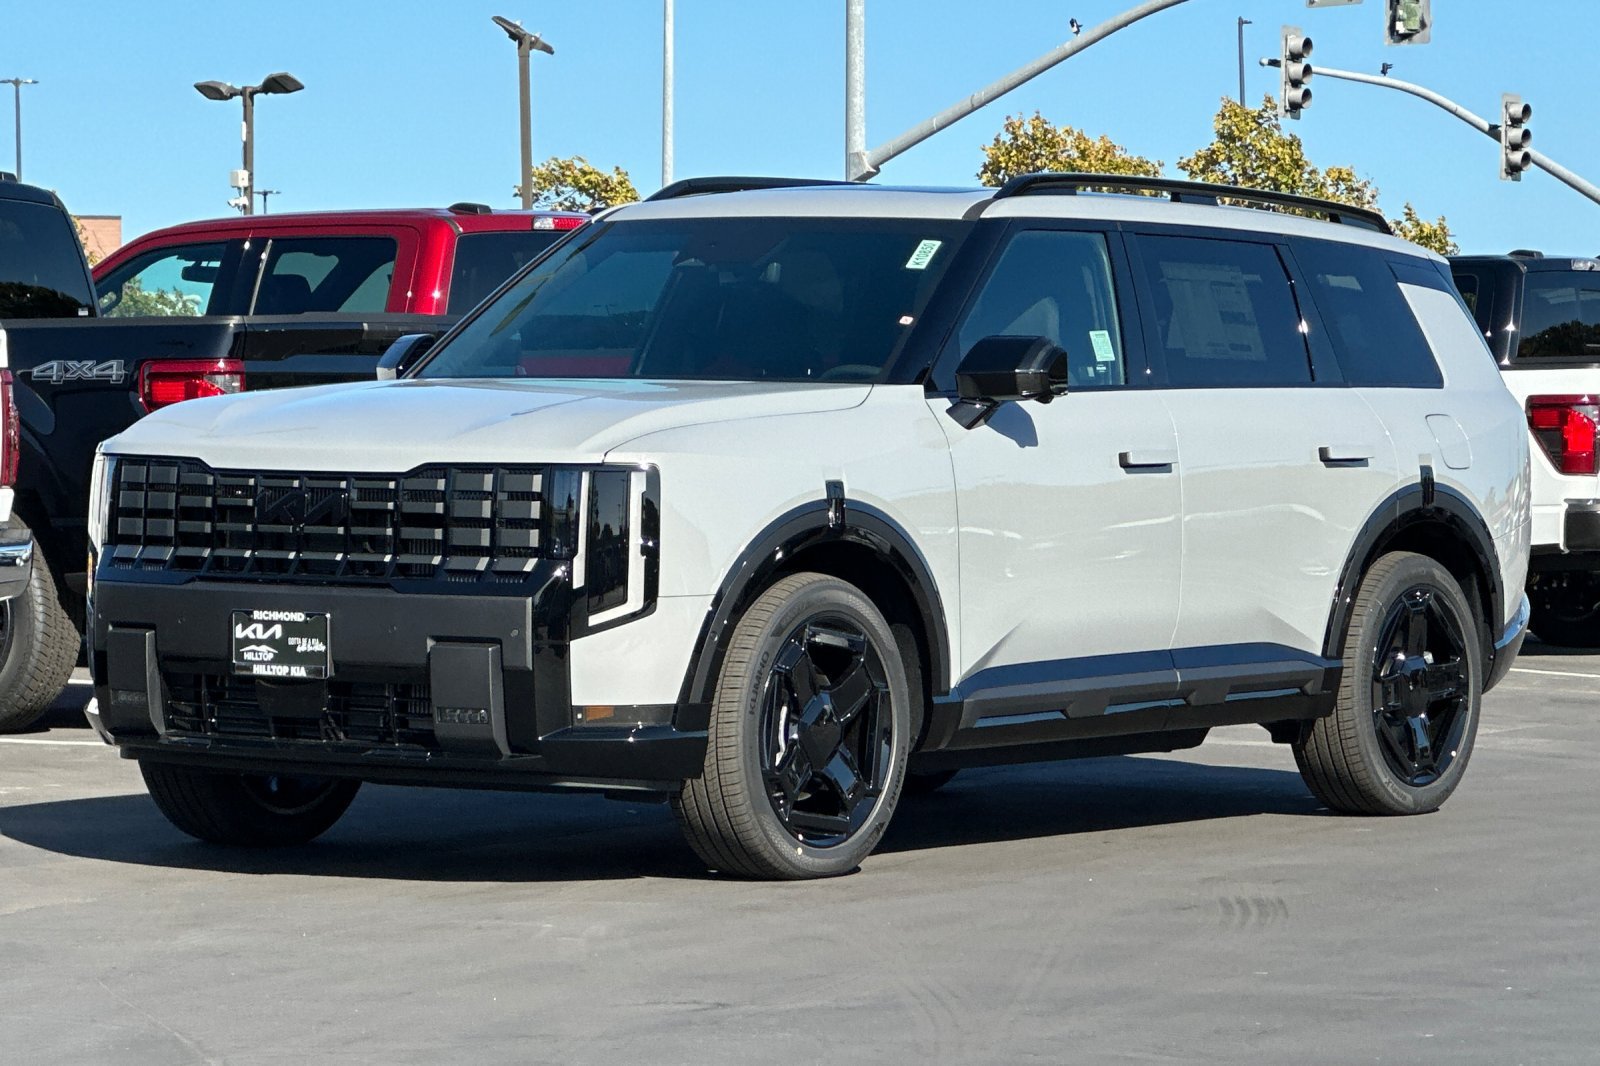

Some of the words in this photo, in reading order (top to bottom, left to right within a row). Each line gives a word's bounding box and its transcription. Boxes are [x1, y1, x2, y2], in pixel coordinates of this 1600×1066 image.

[253, 610, 305, 622] RICHMOND
[235, 623, 283, 640] KIA
[243, 652, 275, 661] HILLTOP
[252, 664, 290, 676] HILLTOP
[290, 666, 307, 677] KIA
